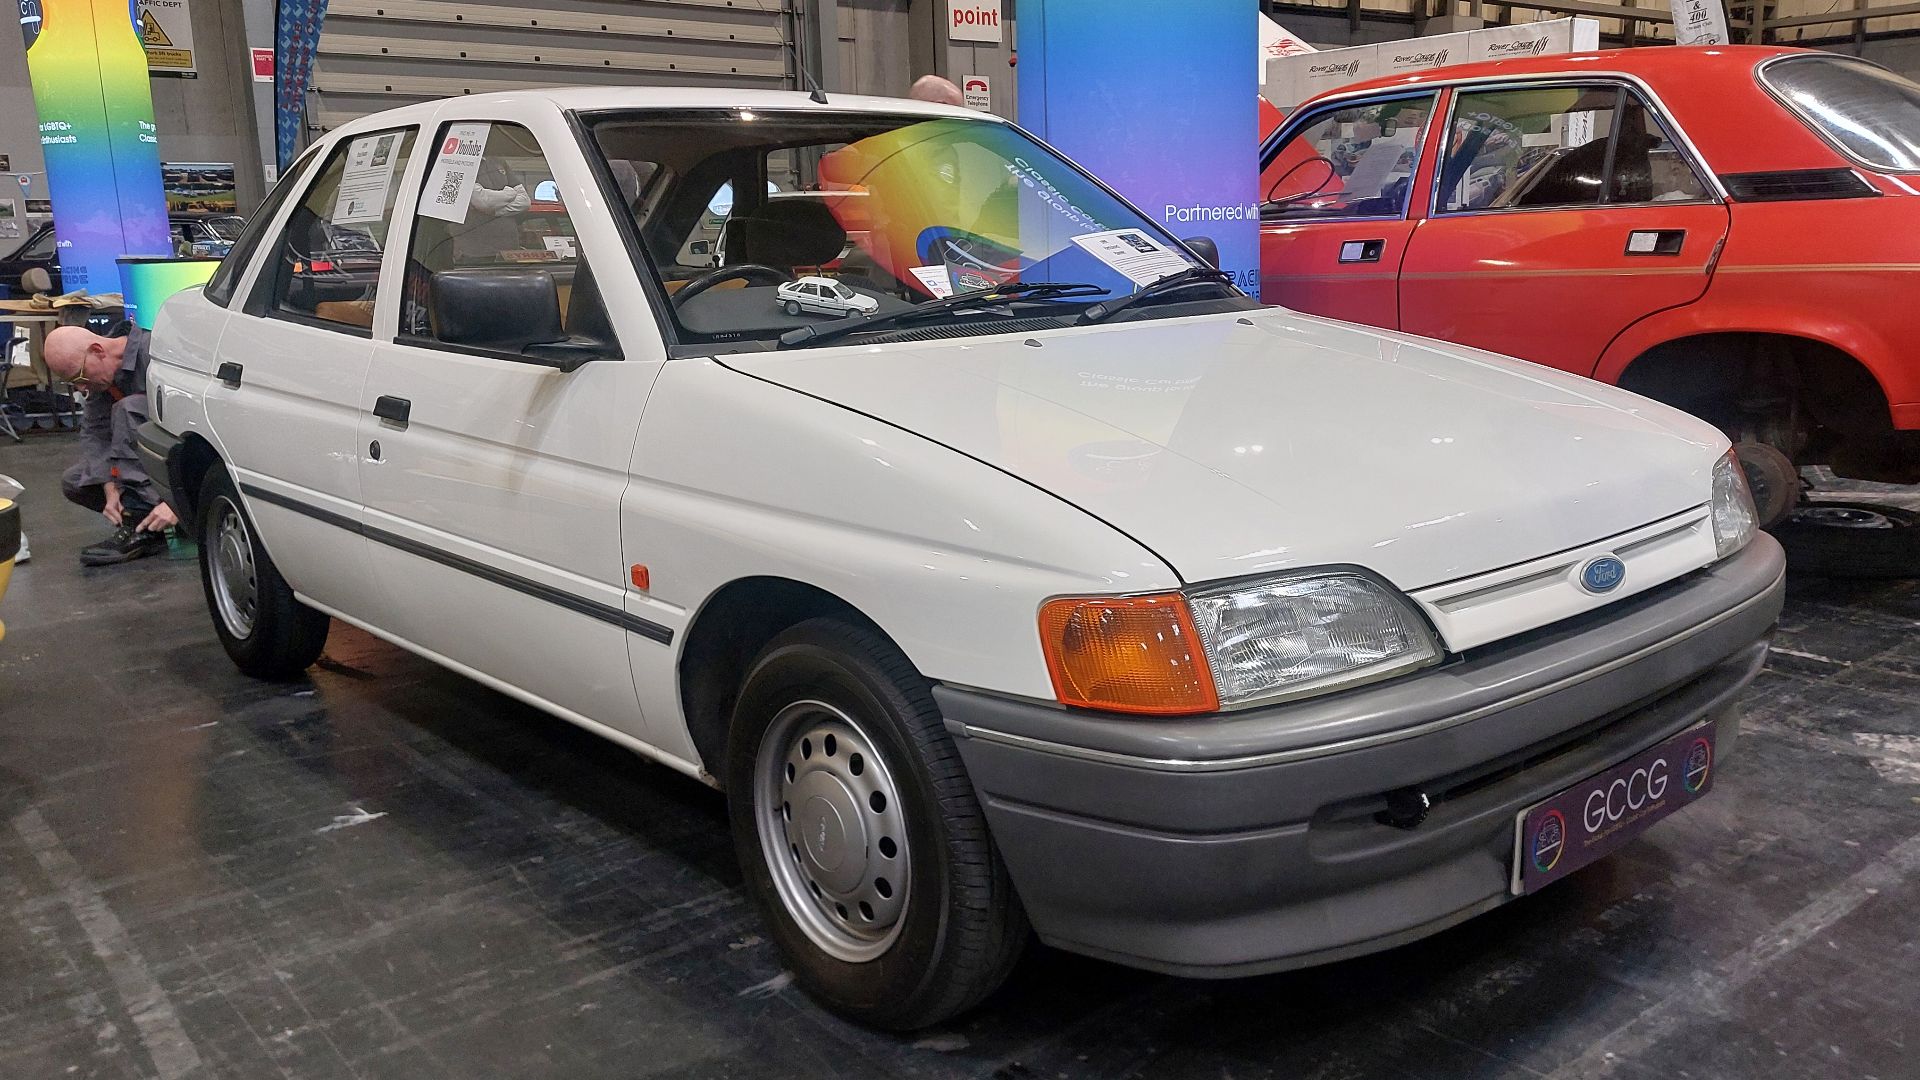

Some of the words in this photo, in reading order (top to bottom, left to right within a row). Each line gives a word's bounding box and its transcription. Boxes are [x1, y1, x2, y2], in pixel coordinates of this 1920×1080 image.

[1692, 0, 1701, 10] &
[953, 6, 998, 27] point
[1689, 10, 1707, 22] 400
[1488, 43, 1510, 52] Rover
[1393, 54, 1414, 63] Rover
[1309, 65, 1328, 73] Rover
[966, 94, 989, 102] Emergency
[138, 120, 150, 130] The
[456, 139, 482, 156] YouTube
[1165, 202, 1243, 223] Partnered
[1594, 562, 1617, 584] Ford
[1583, 758, 1669, 833] GCCG
